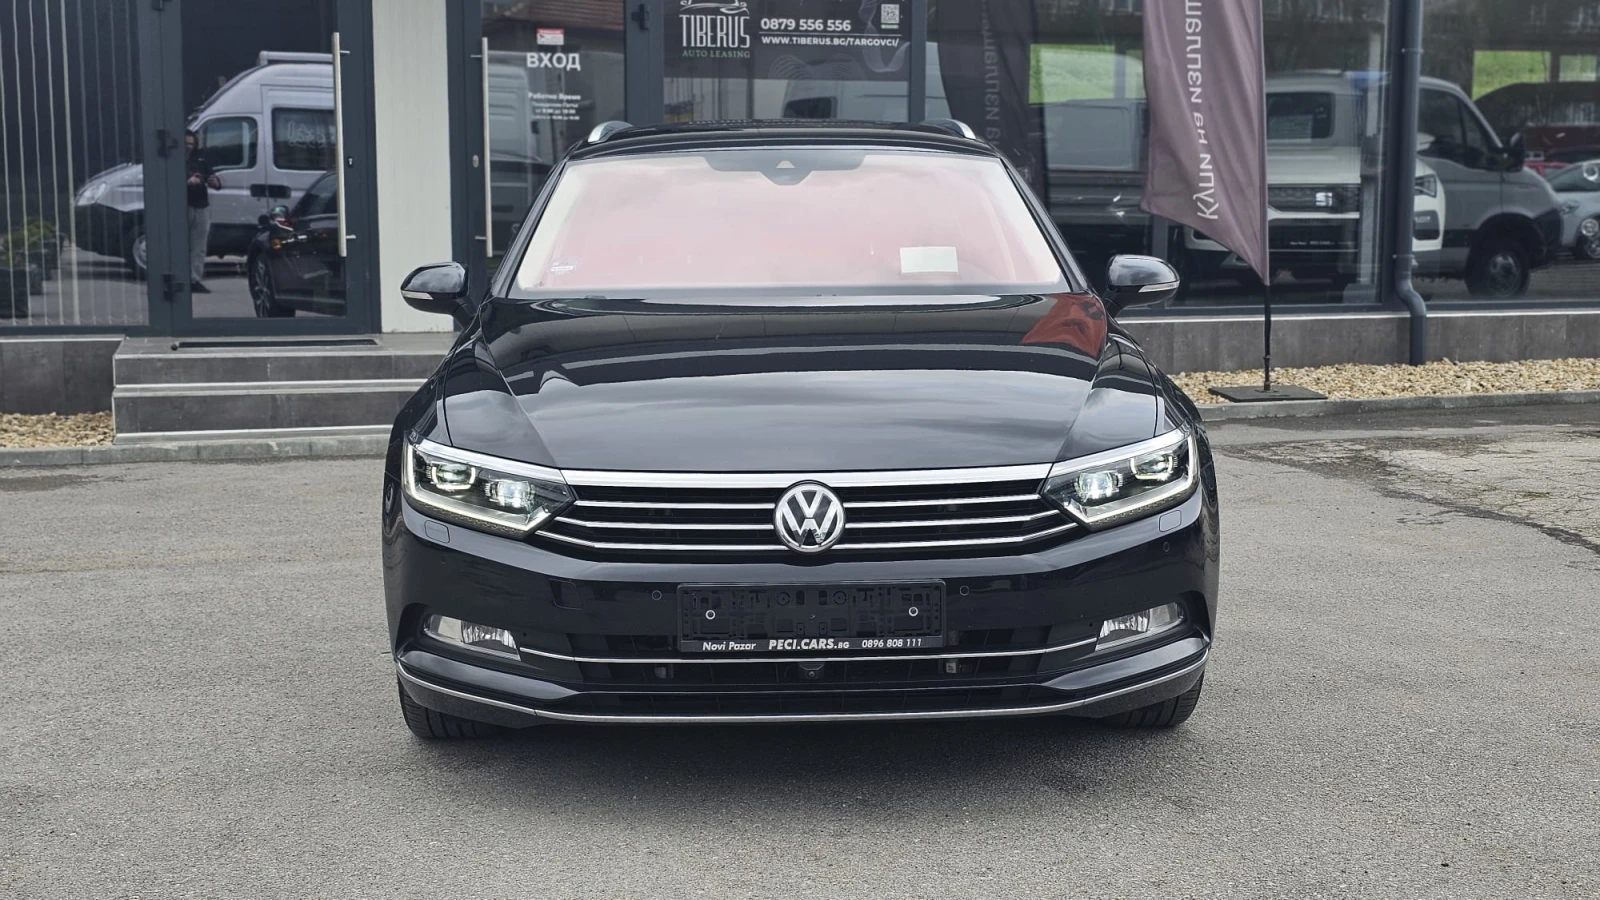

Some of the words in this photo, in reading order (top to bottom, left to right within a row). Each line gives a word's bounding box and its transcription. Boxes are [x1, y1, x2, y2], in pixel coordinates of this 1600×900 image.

[679, 14, 750, 48] TIBERUS
[760, 18, 795, 31] 0879
[799, 19, 824, 31] 556
[826, 19, 852, 31] 556
[761, 36, 900, 47] WWW.TIBERUS.BG/TARGOVCI/
[682, 50, 707, 58] AUTO
[709, 50, 750, 59] LEASING
[526, 52, 581, 71] ВХОД
[703, 641, 726, 651] Novi
[729, 641, 756, 651] Pazar
[768, 638, 850, 651] PECI.CARS.BG
[862, 639, 884, 648] 0896
[886, 638, 903, 647] 808
[906, 638, 922, 647] 111
